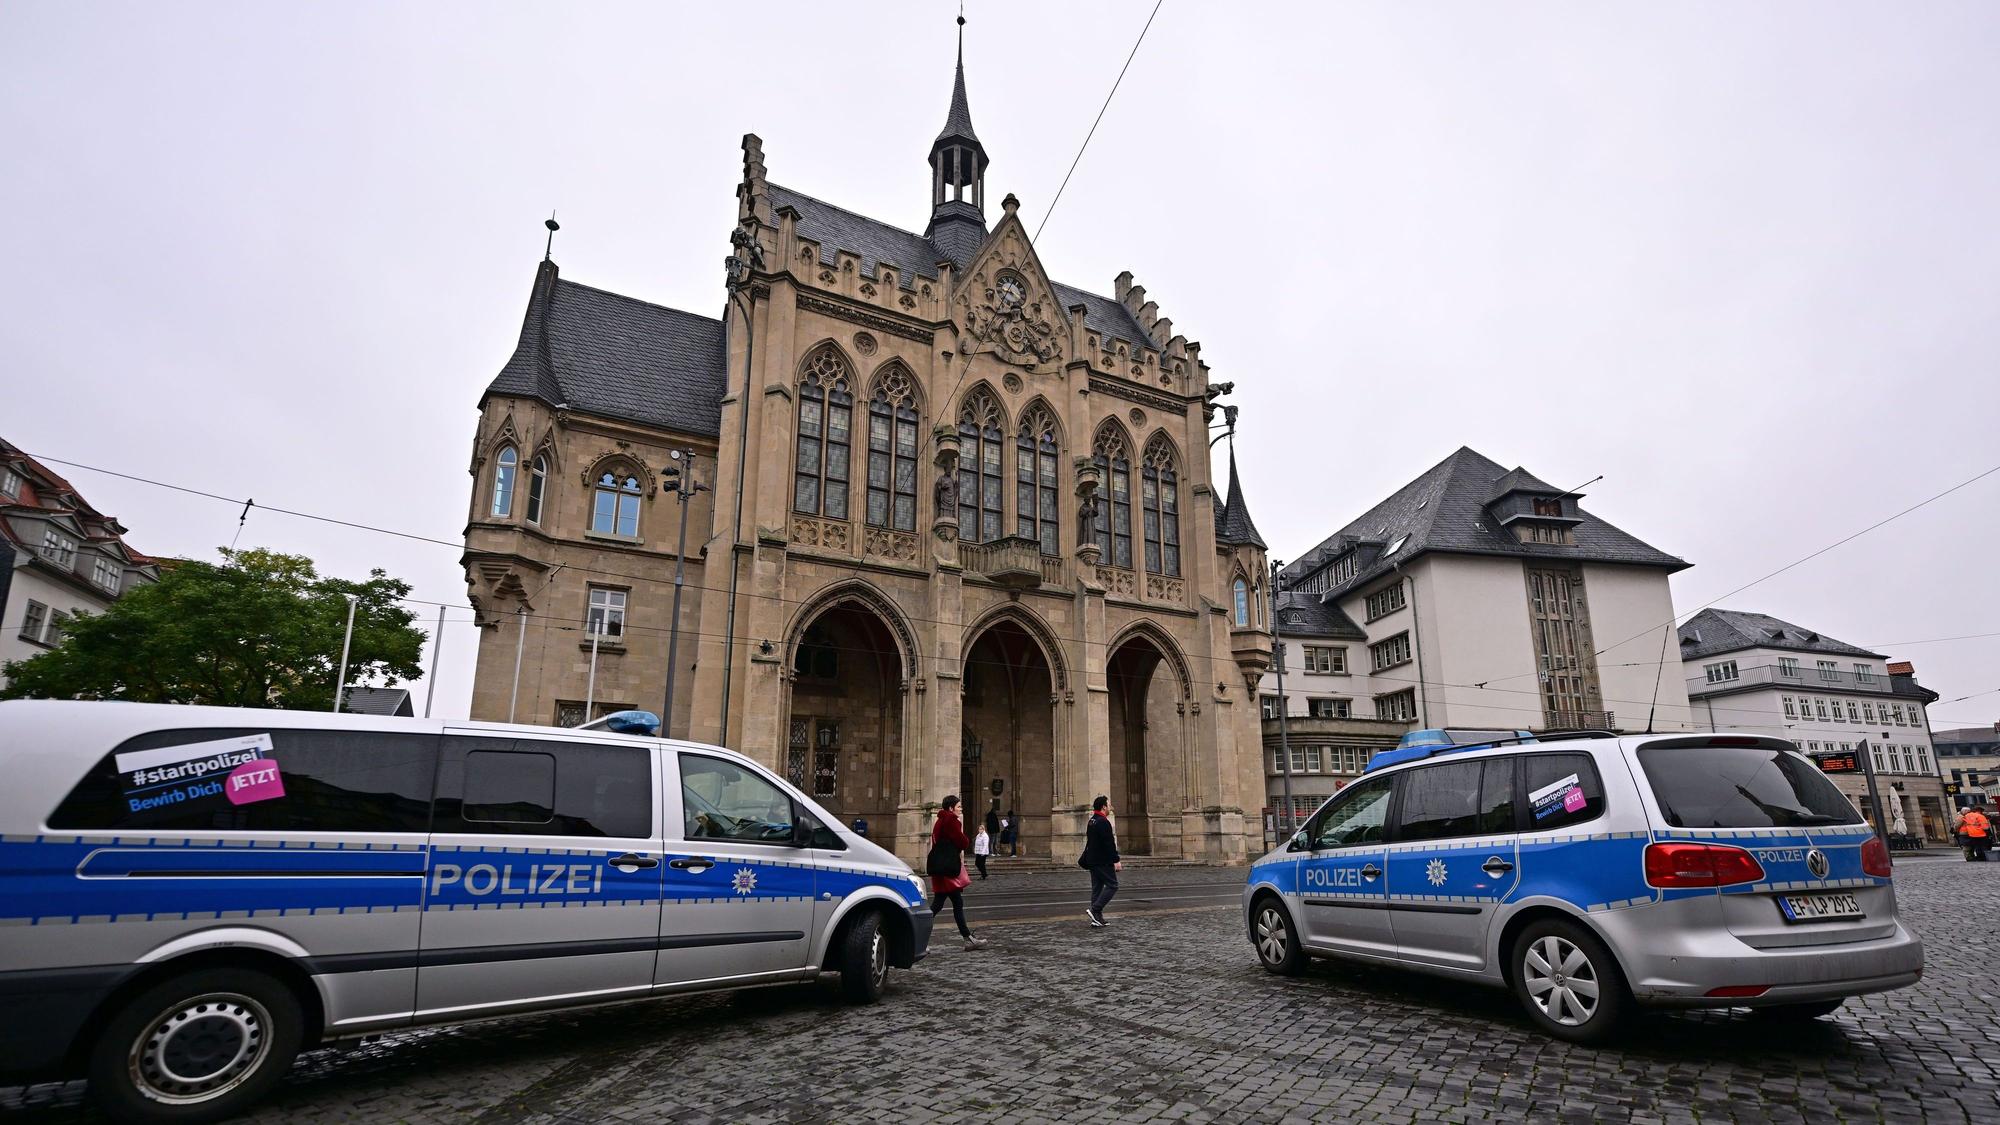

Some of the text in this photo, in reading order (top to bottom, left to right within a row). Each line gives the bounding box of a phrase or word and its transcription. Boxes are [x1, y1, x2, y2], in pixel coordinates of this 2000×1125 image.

[133, 749, 258, 786] #startpolizei
[232, 768, 275, 792] JETZT
[129, 781, 223, 812] Bewirb Dich
[1535, 784, 1575, 807] #startpolizei
[1566, 792, 1582, 806] JETZT
[1759, 849, 1804, 863] POLIZEI
[430, 863, 603, 896] POLIZEI
[1306, 868, 1361, 887] POLIZEI
